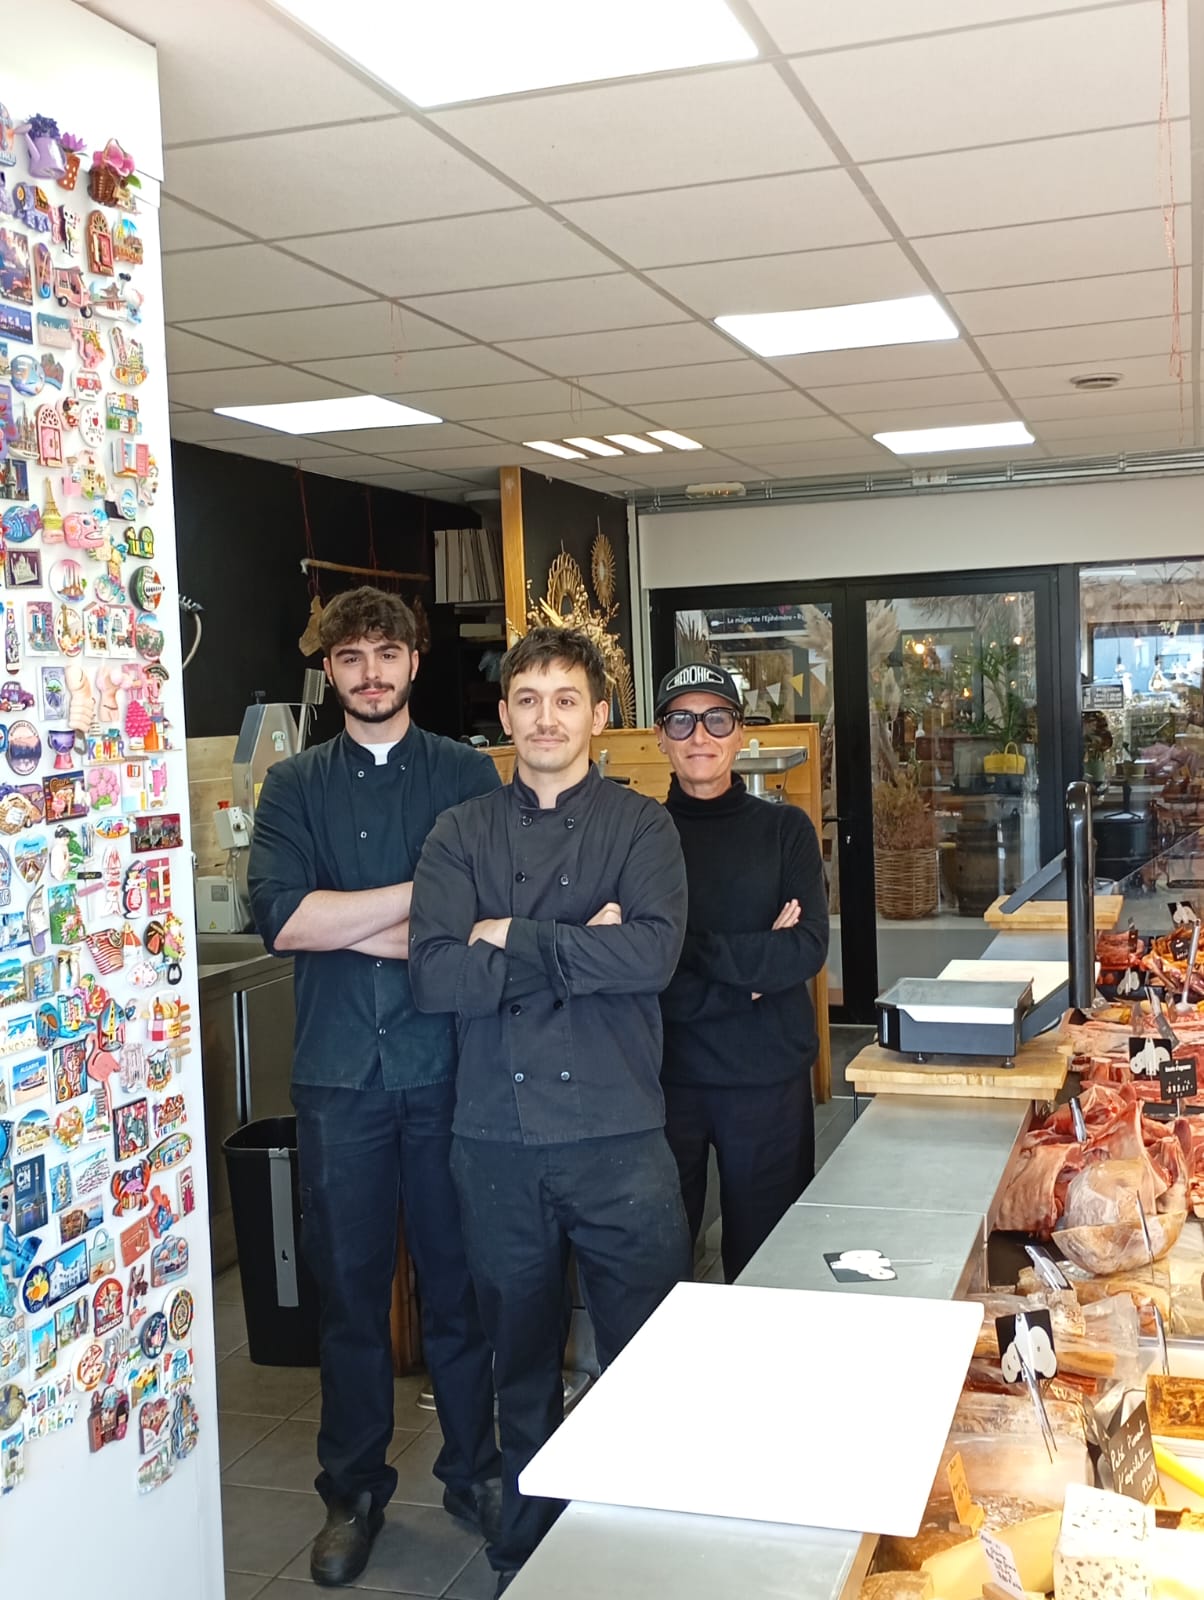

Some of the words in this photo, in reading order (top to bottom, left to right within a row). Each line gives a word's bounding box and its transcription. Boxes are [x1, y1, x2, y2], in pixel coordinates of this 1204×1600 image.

[666, 666, 724, 691] HEDONIC
[88, 737, 124, 760] KEMER
[16, 1169, 31, 1187] CN
